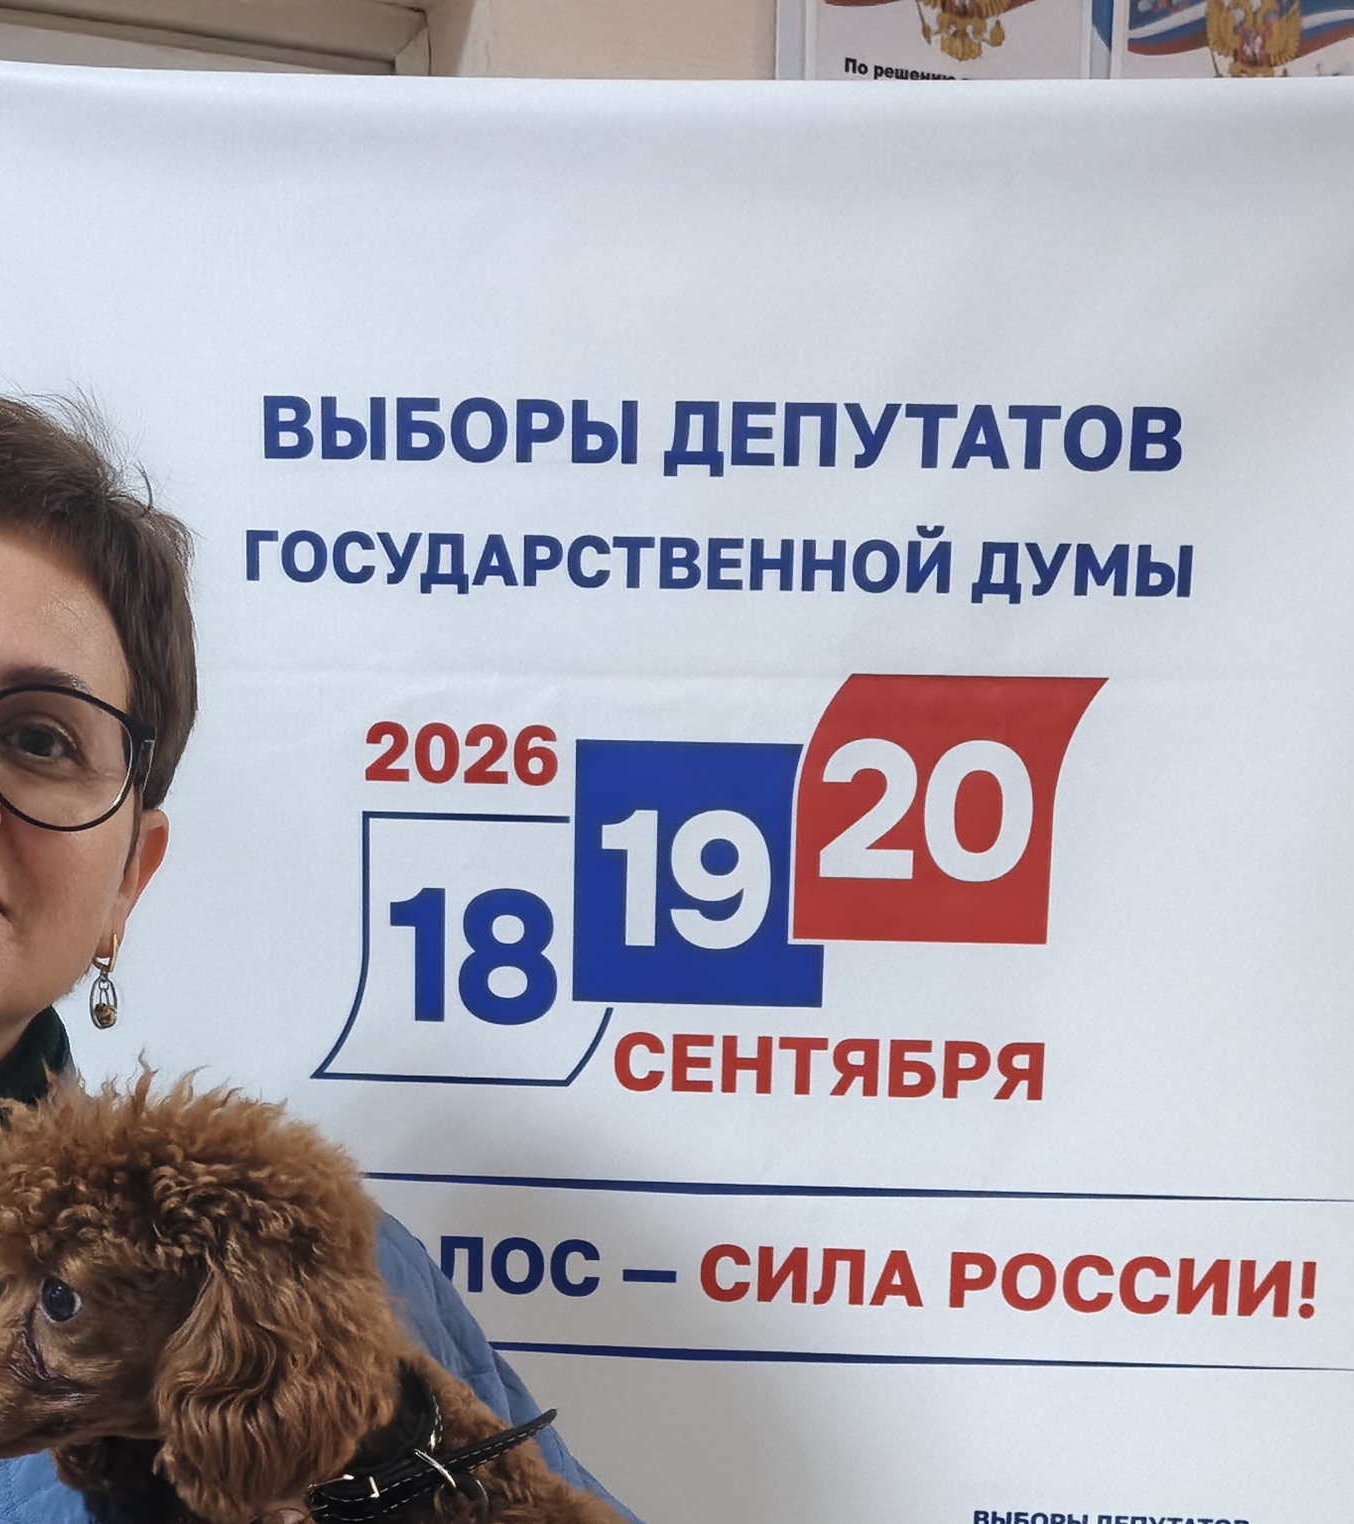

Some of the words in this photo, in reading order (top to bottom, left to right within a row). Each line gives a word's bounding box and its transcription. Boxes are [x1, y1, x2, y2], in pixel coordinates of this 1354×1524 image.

[844, 57, 869, 75] По
[263, 395, 639, 465] ВЫБОРЫ
[663, 400, 1183, 478] ДЕПУТАТОВ
[245, 525, 952, 595] ГОСУДАРСТВЕННОЙ
[970, 541, 1194, 605] ДУМЫ
[365, 721, 558, 787] 2026
[818, 737, 1034, 883] 20
[601, 809, 772, 950] 19
[389, 887, 558, 1026] 18
[613, 1031, 1045, 1101] СЕНТЯБРЯ
[420, 1235, 601, 1297] ЛОС
[699, 1243, 923, 1307] СИЛА
[949, 1251, 1317, 1319] РОССИИ!
